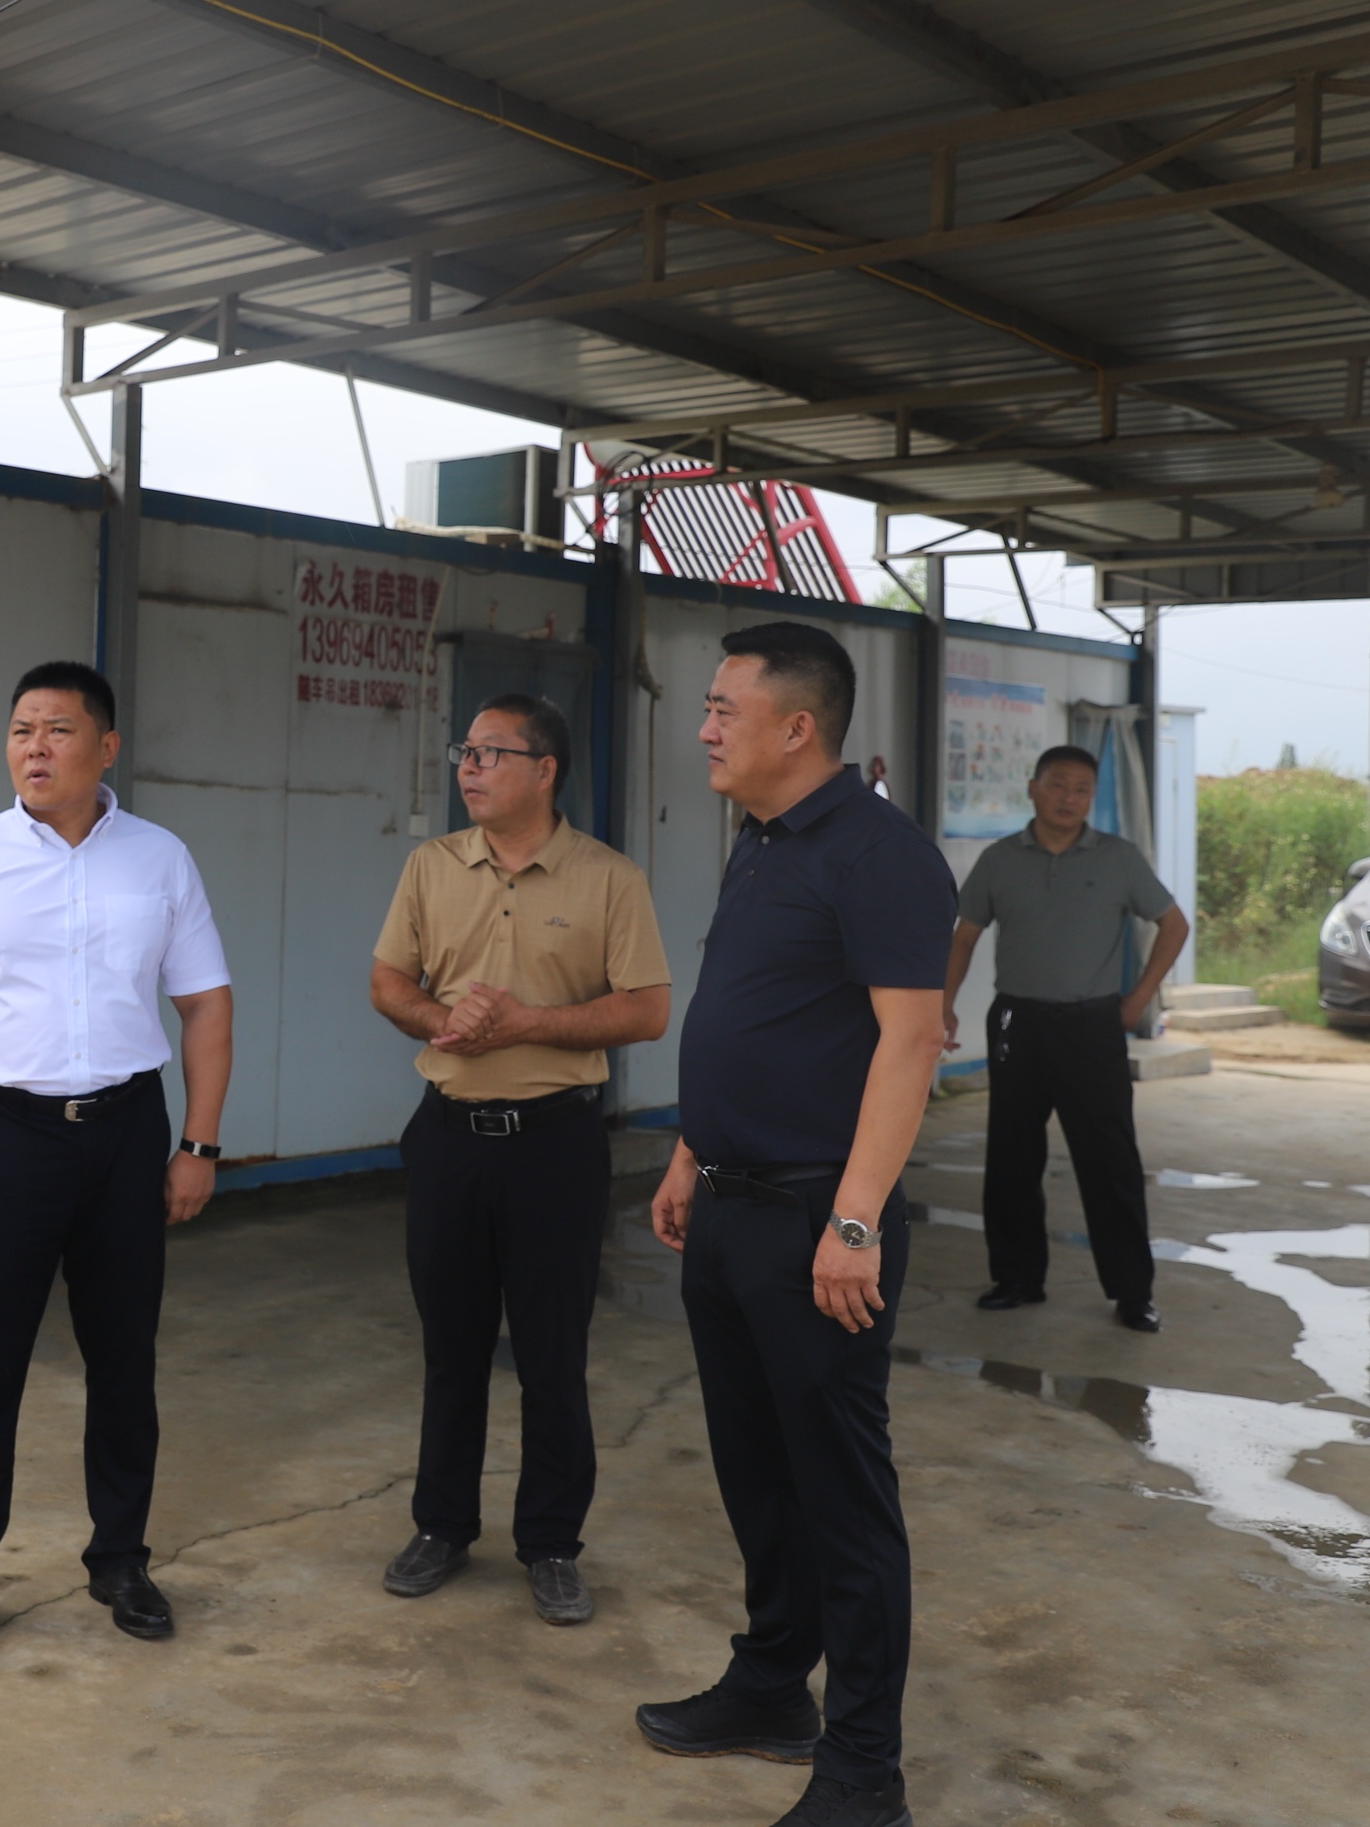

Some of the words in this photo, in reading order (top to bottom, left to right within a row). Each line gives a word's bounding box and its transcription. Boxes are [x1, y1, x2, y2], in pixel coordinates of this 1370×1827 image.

[300, 559, 441, 623] 永久箱房租售
